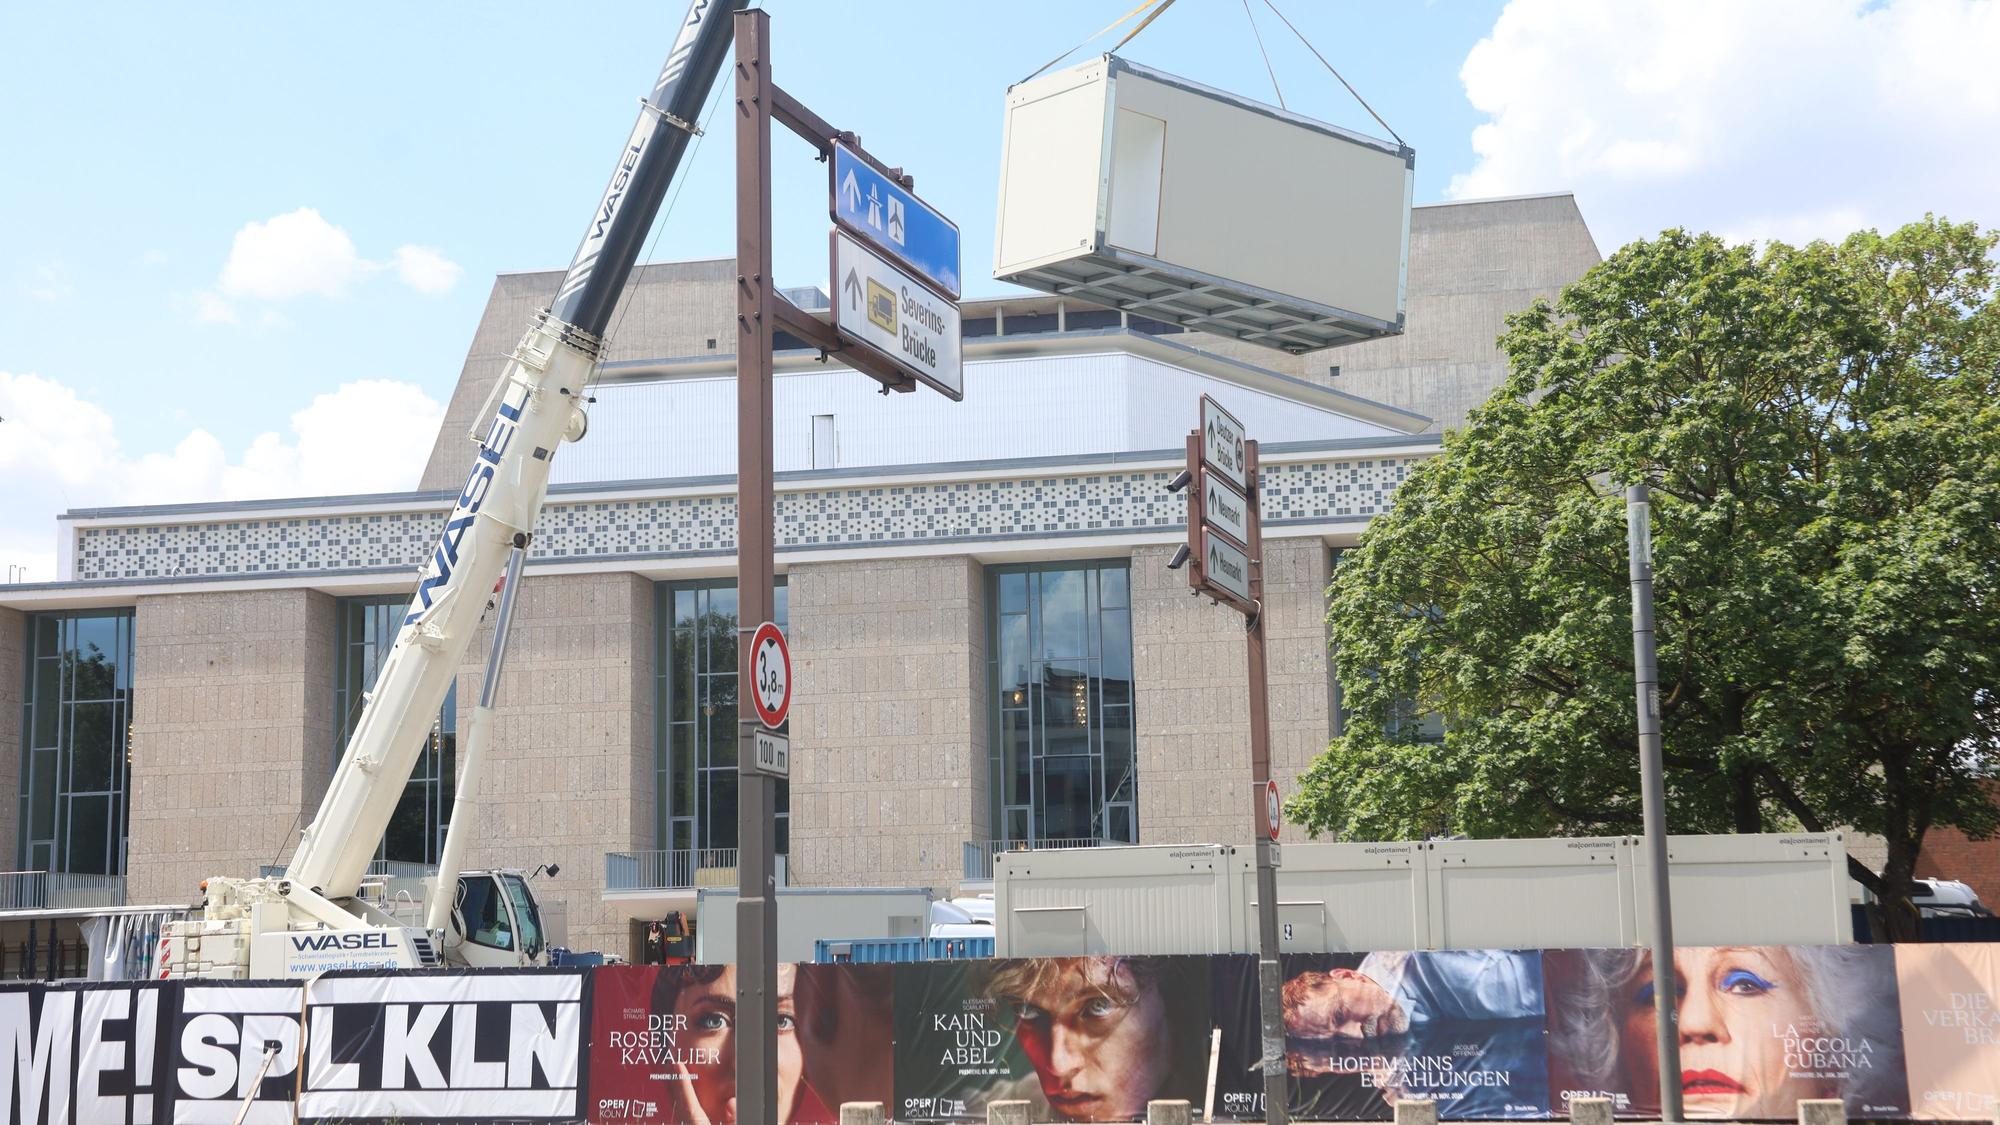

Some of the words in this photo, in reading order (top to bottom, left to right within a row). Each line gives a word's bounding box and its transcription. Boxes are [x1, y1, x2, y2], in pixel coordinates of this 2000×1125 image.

[590, 136, 647, 241] WASEL
[900, 284, 946, 337] Severins-
[902, 322, 937, 369] Brücke
[1217, 443, 1233, 472] Brücke
[403, 390, 531, 627] WASEL
[1218, 493, 1241, 528] Neumarkt
[1219, 551, 1242, 584] Heumarkt
[759, 738, 774, 765] 100
[777, 750, 785, 768] m
[291, 932, 398, 951] WASEL
[1951, 991, 1990, 1010] DIE
[648, 1014, 688, 1031] DER
[934, 1013, 985, 1031] KAIN
[1772, 1023, 1800, 1038] LA
[380, 1002, 579, 1090] KLN
[609, 1031, 677, 1048] ROSEN
[956, 1030, 1001, 1047] UND
[1783, 1038, 1873, 1054] PICCOLA
[0, 987, 158, 1125] ME!
[621, 1047, 721, 1065] KAVALIER
[940, 1047, 995, 1065] ABEL
[1329, 1055, 1453, 1072] HOFFMANNS
[1783, 1053, 1873, 1069] CUBANA
[1360, 1071, 1510, 1088] ERZÄHLUNGEN
[599, 1099, 625, 1109] OPER
[904, 1098, 931, 1108] OPER
[1223, 1092, 1252, 1103] OPER
[599, 1108, 621, 1118] KÖLN
[905, 1108, 929, 1118] KÖLN
[1224, 1102, 1249, 1113] KÖLN
